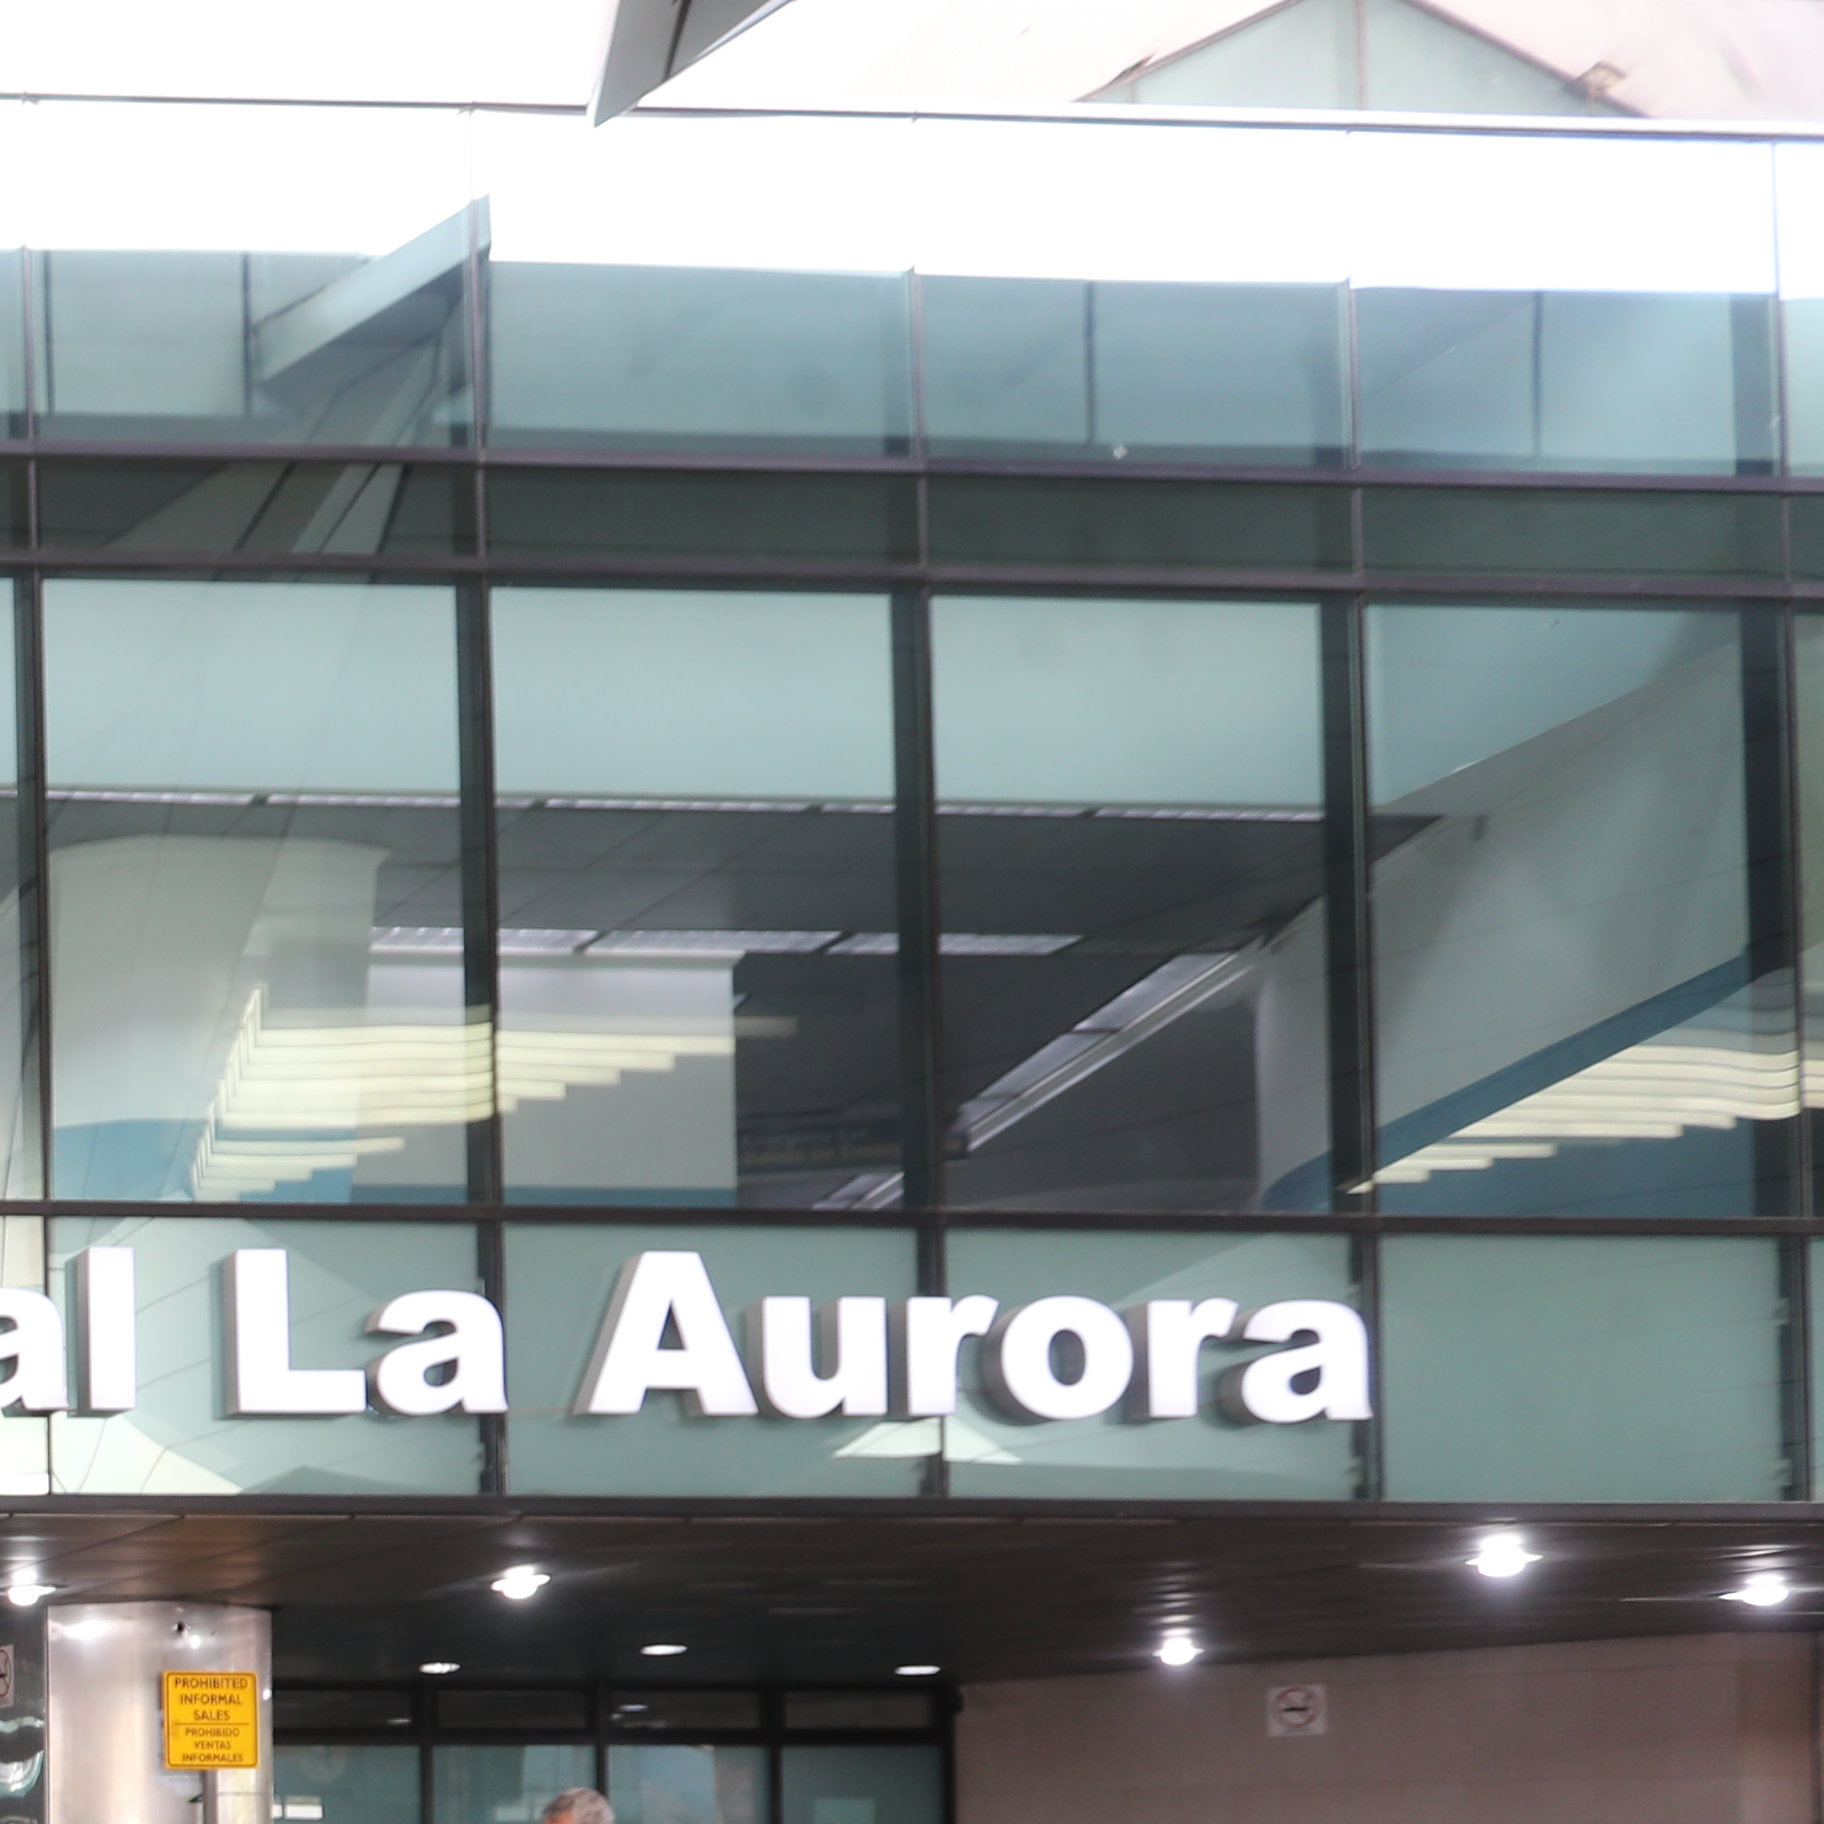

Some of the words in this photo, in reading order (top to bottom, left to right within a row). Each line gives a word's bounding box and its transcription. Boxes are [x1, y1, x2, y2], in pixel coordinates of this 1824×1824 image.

[224, 1247, 508, 1417] La
[578, 1249, 1374, 1422] Aurora
[174, 1677, 249, 1690] PROHIBITED
[180, 1693, 244, 1705] INFORMAL
[193, 1709, 231, 1721] SALES
[185, 1727, 241, 1737] PROHIBIDO
[194, 1740, 232, 1750] VENTAS
[182, 1753, 244, 1763] INFORMALES
